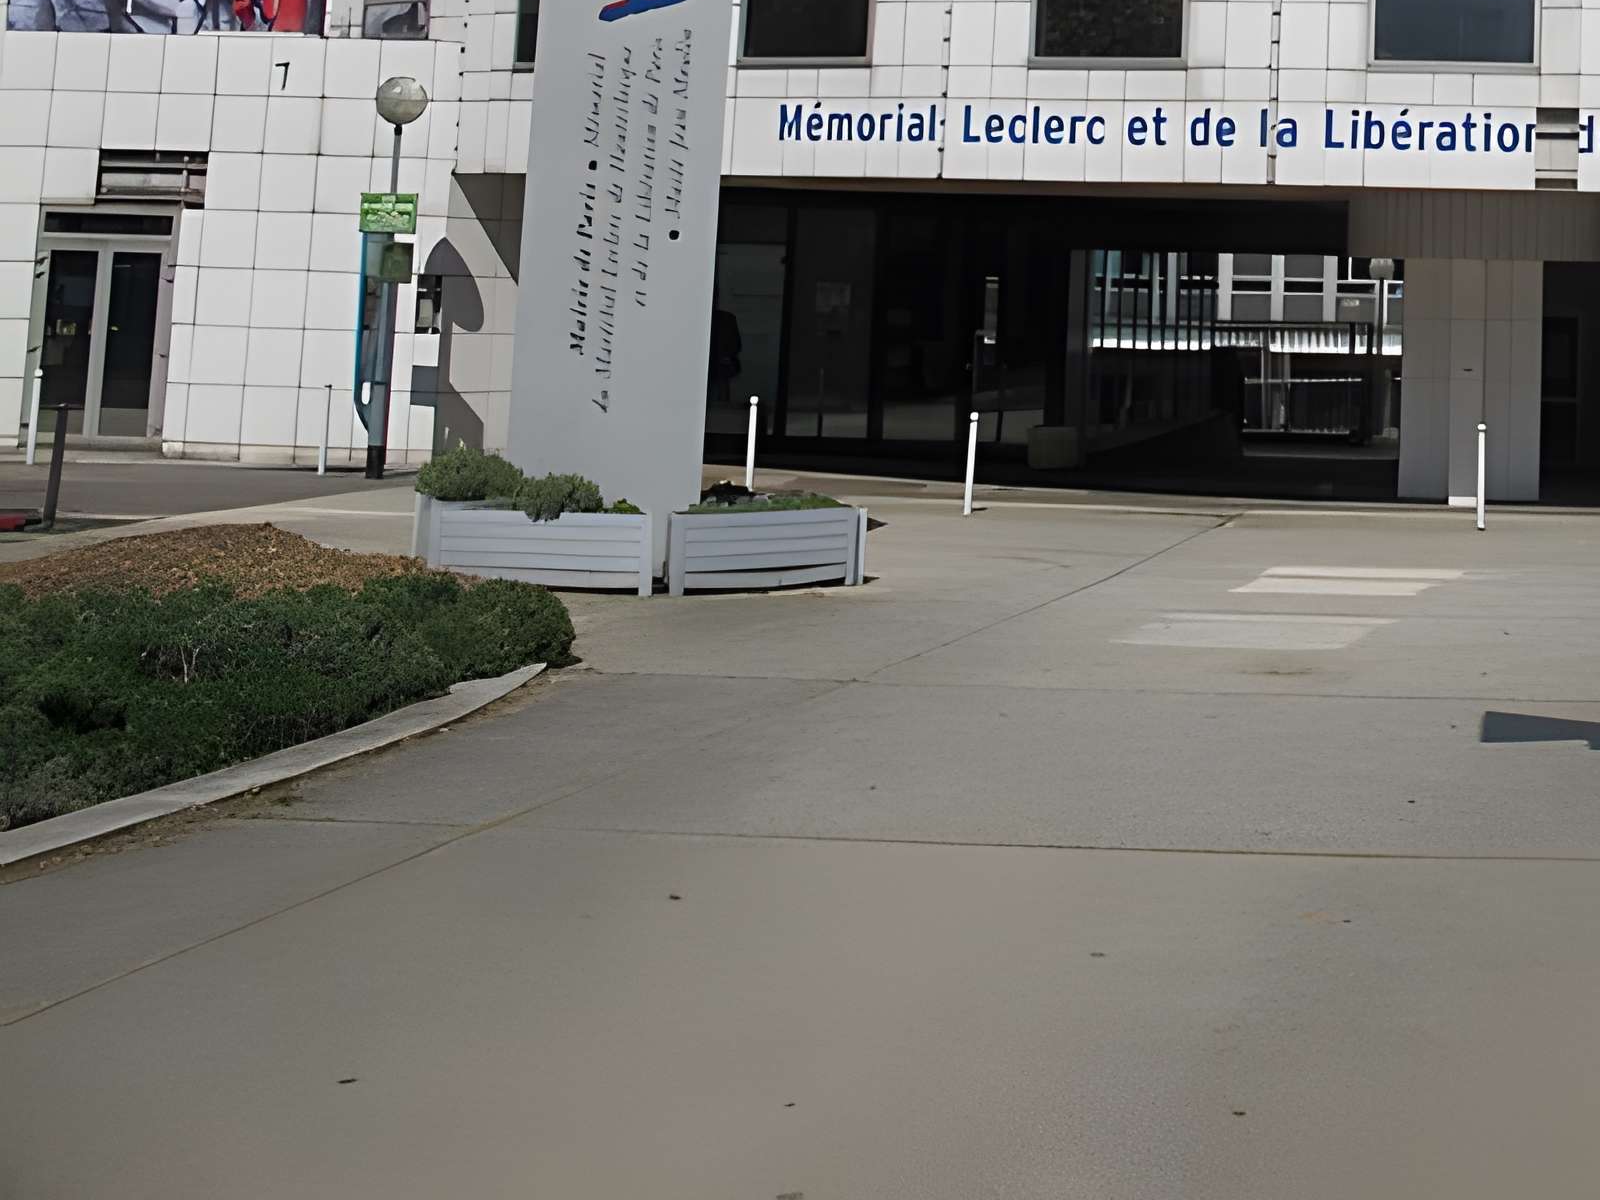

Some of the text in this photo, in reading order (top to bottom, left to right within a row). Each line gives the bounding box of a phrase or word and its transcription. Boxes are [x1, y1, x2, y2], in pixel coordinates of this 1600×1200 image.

[779, 102, 936, 142] Mémorial
[962, 104, 1105, 146] Leclerc
[1127, 109, 1168, 147] et
[1190, 108, 1236, 149] de
[1260, 110, 1298, 150] la
